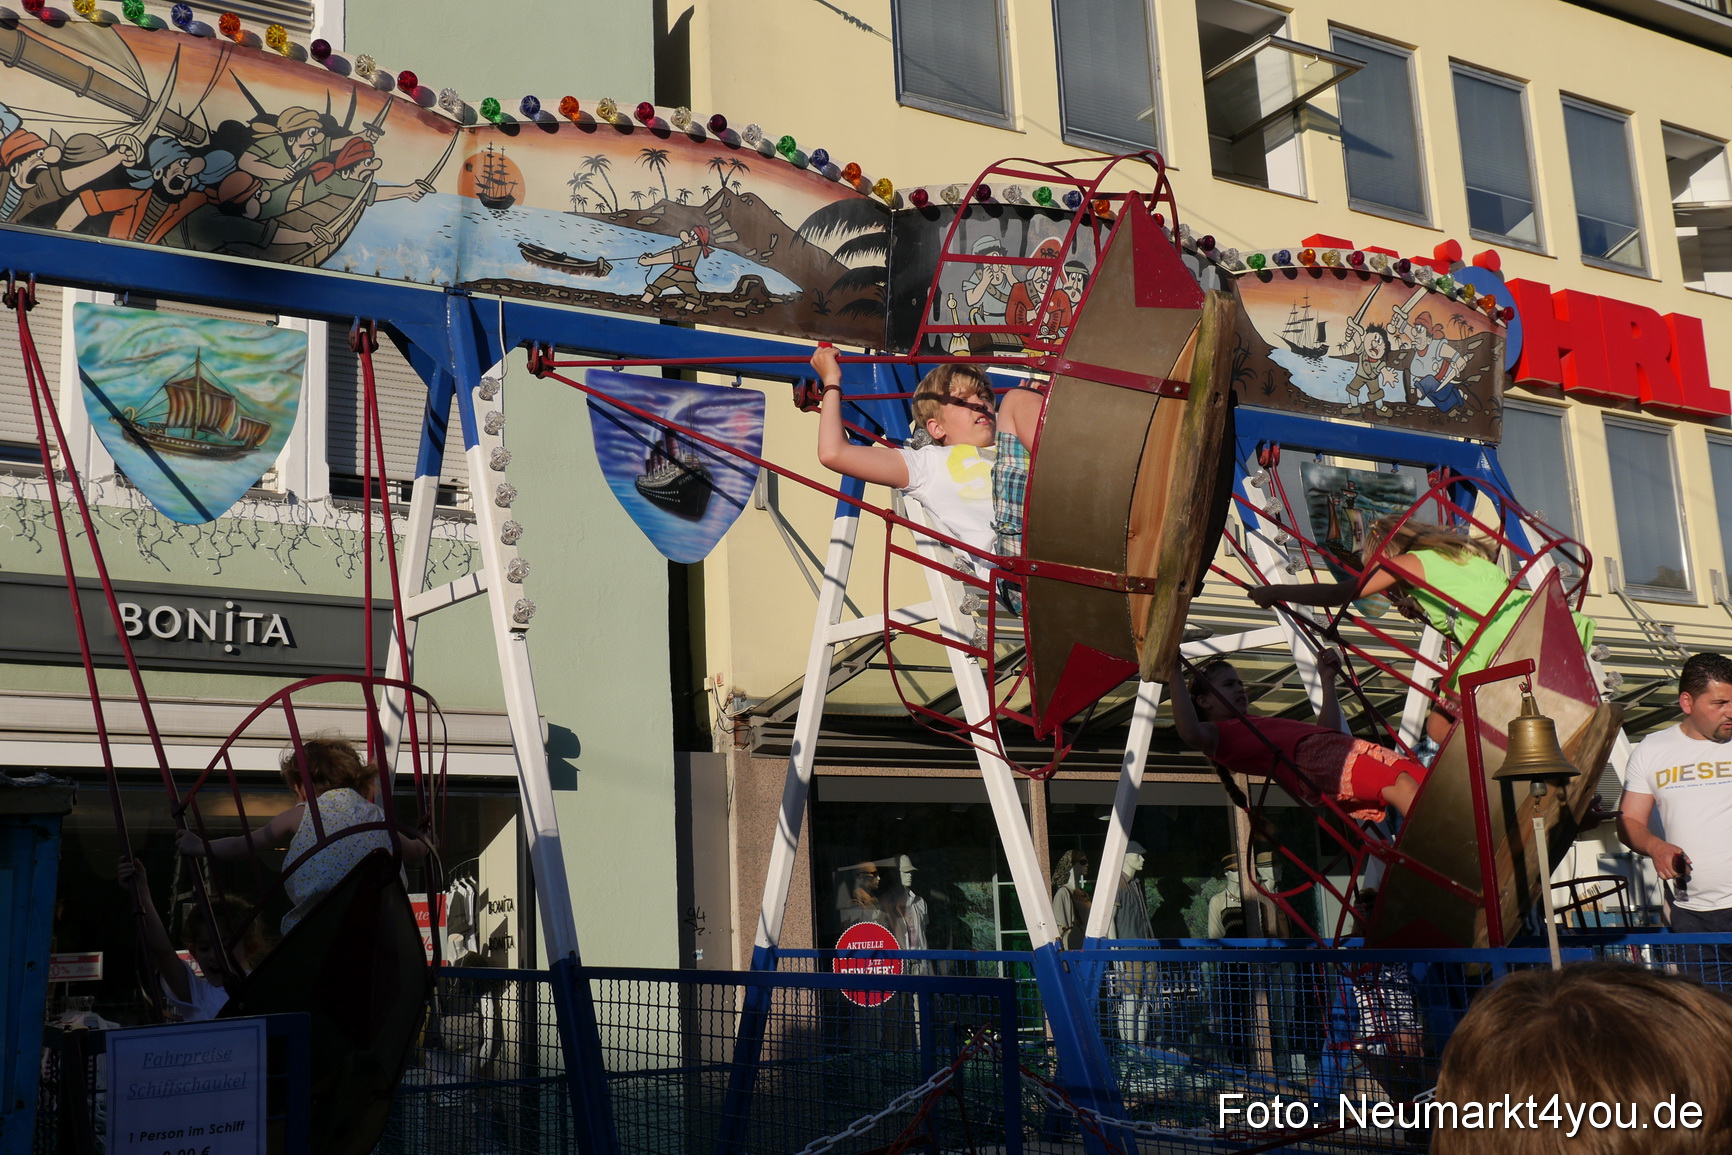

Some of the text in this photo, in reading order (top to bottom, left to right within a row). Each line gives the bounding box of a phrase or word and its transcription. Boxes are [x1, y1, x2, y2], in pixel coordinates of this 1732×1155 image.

[1655, 761, 1732, 790] DIESE
[846, 940, 884, 950] AKTUELLE
[142, 1047, 233, 1070] Fahrpreise
[126, 1072, 247, 1101] Schiffschaukel
[129, 1120, 246, 1143] 1 Person im Schiff
